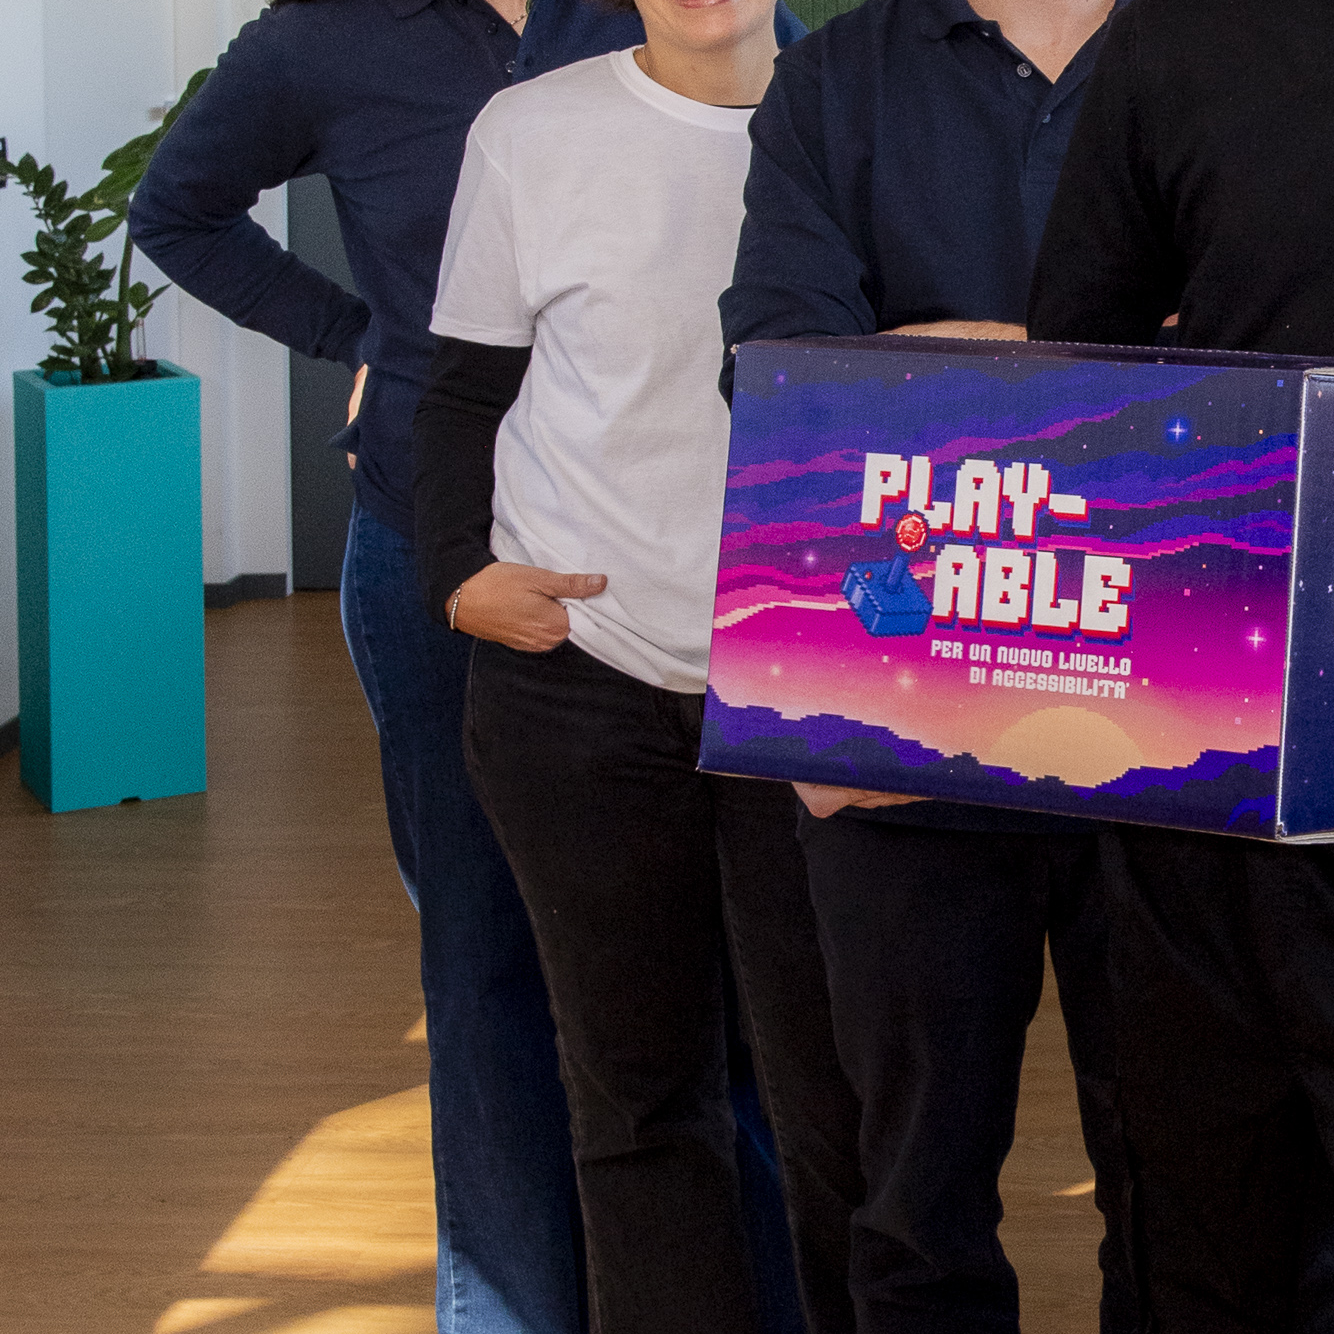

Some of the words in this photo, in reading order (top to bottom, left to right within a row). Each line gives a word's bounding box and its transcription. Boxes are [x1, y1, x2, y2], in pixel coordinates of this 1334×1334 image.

[861, 452, 1088, 542] PLAY-
[931, 543, 1133, 638] ABLE
[930, 639, 963, 660] PER
[968, 643, 992, 662] UN
[996, 645, 1054, 668] NUOVO
[1058, 651, 1132, 677] LIVELLO
[969, 666, 987, 685] DI
